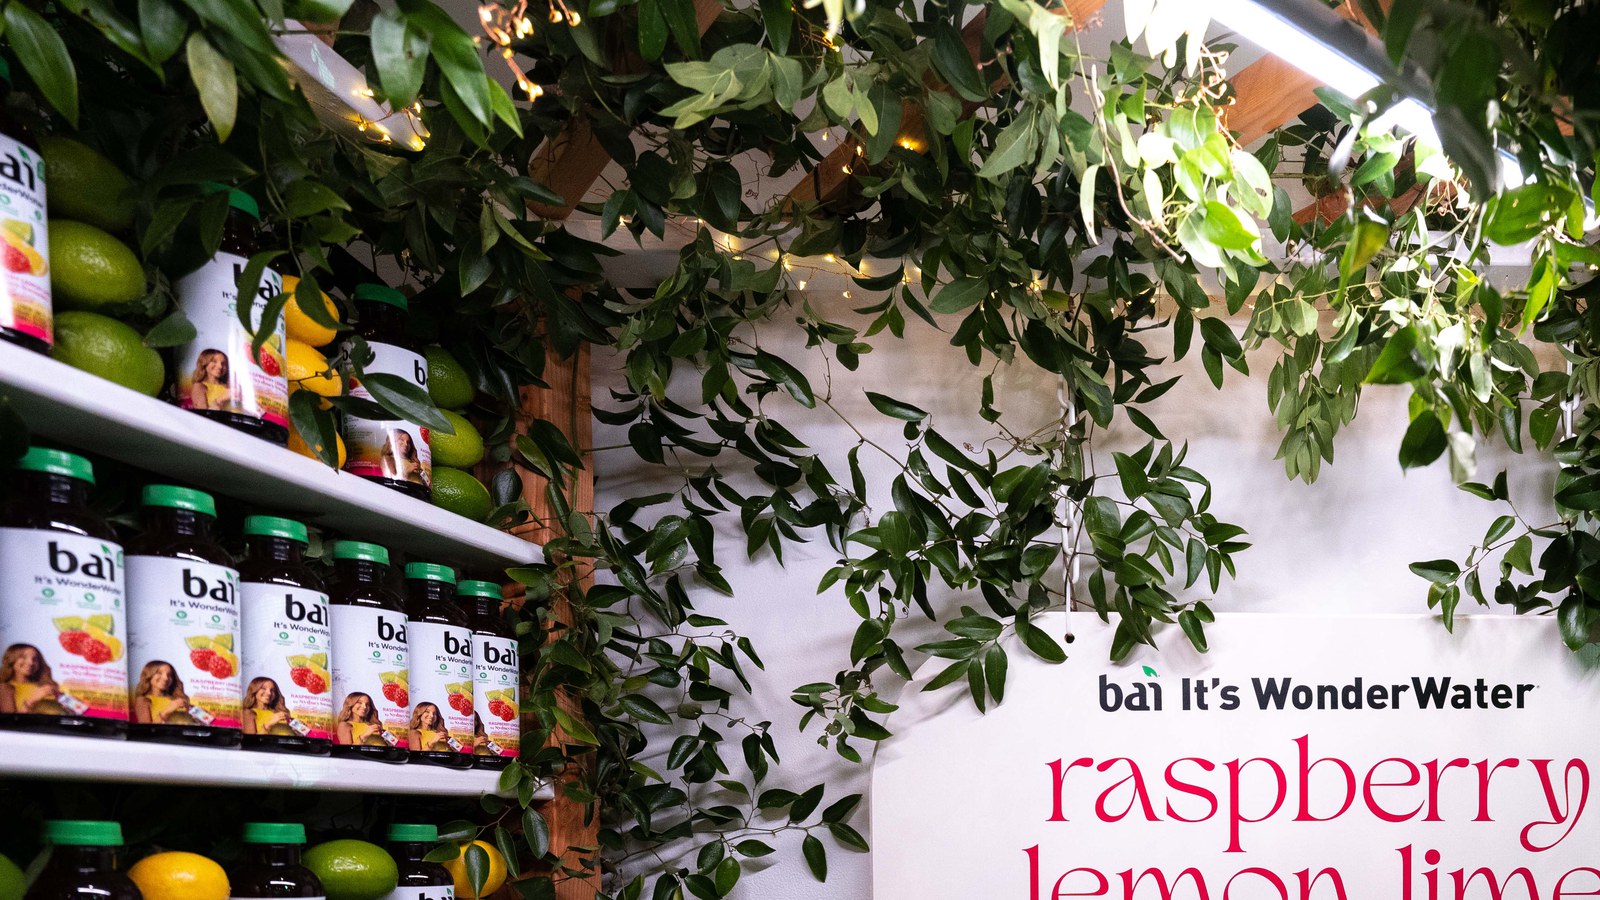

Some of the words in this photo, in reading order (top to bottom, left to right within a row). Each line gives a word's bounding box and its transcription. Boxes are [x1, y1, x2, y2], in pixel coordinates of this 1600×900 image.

[48, 541, 115, 582] bai
[182, 569, 234, 605] bai
[285, 594, 328, 627] bai
[377, 615, 408, 644] ba
[484, 641, 516, 666] bai
[1099, 665, 1162, 712] bai
[1181, 677, 1241, 711] It's
[1251, 676, 1535, 710] WonderWater
[1045, 733, 1590, 853] raspberry
